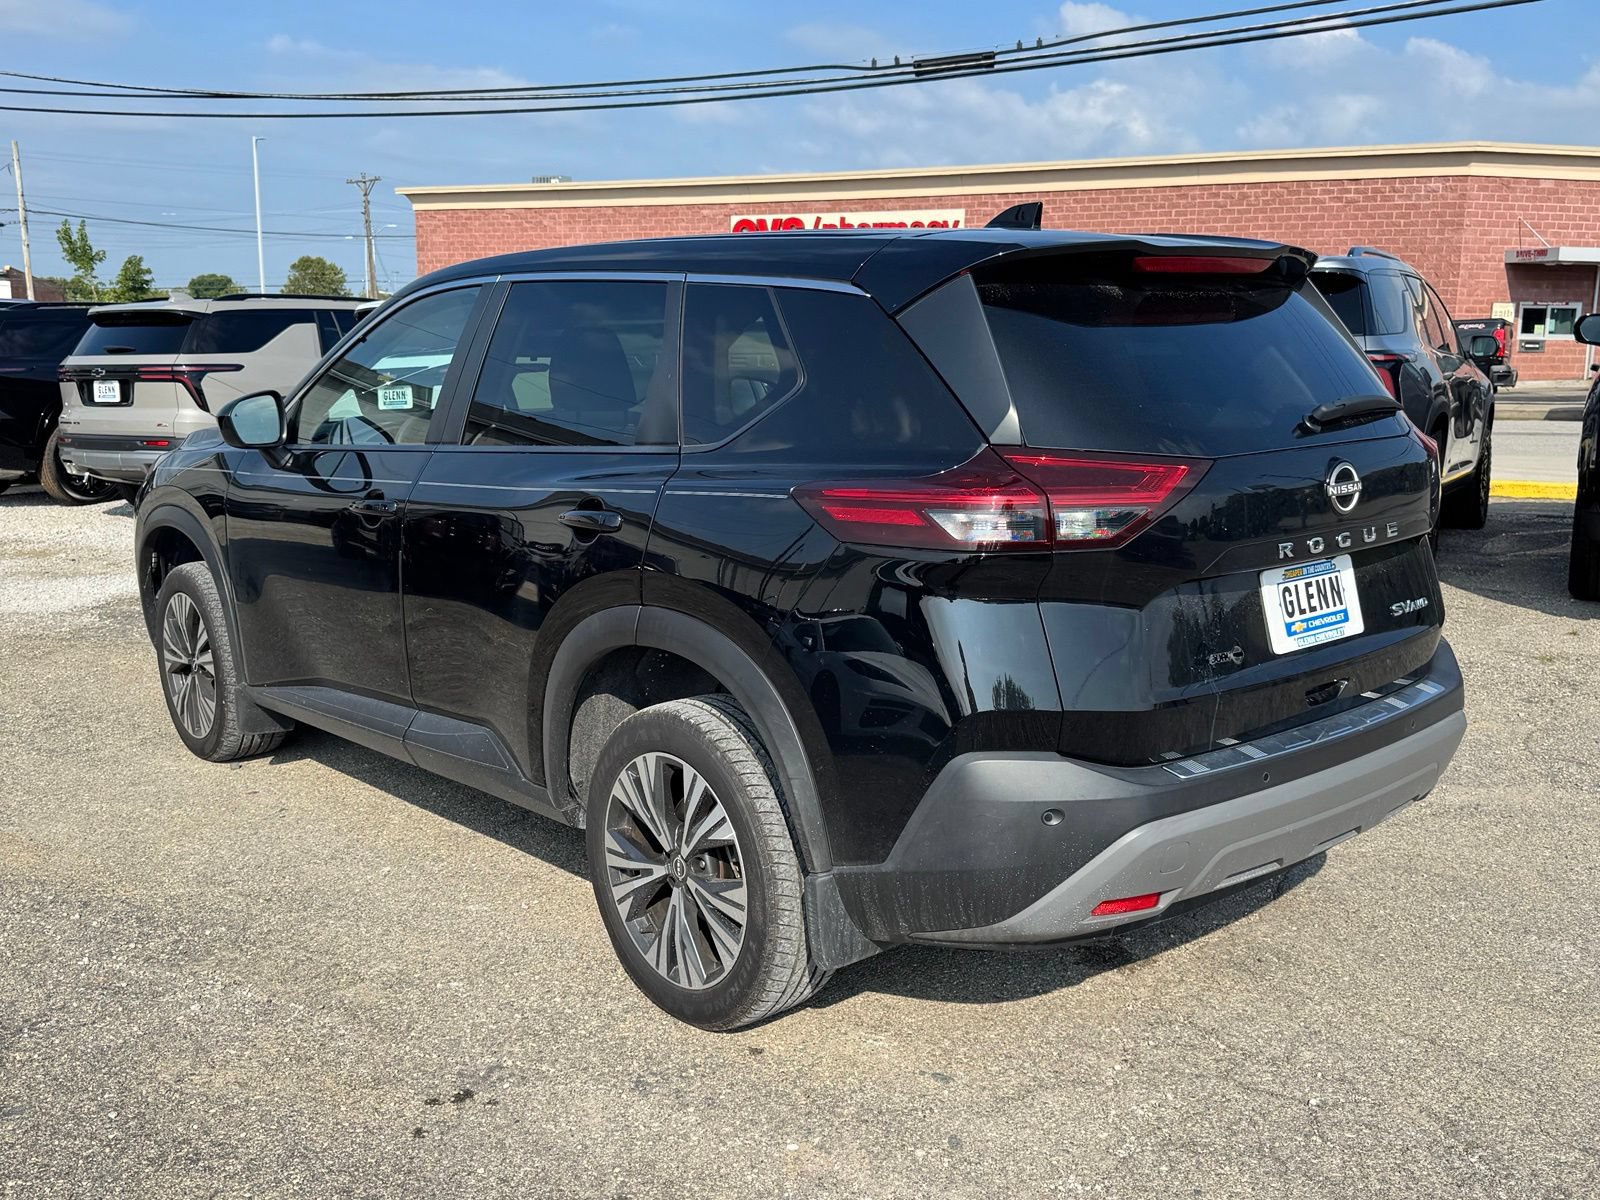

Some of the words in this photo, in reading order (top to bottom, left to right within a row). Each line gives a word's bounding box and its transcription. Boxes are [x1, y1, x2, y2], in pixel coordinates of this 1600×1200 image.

[98, 385, 115, 394] GLENN
[383, 390, 406, 401] GLENN
[1330, 482, 1362, 495] NISSAN
[1278, 521, 1399, 559] ROGUE
[1282, 575, 1343, 618] GLENN
[1308, 613, 1345, 628] CHEVROLET
